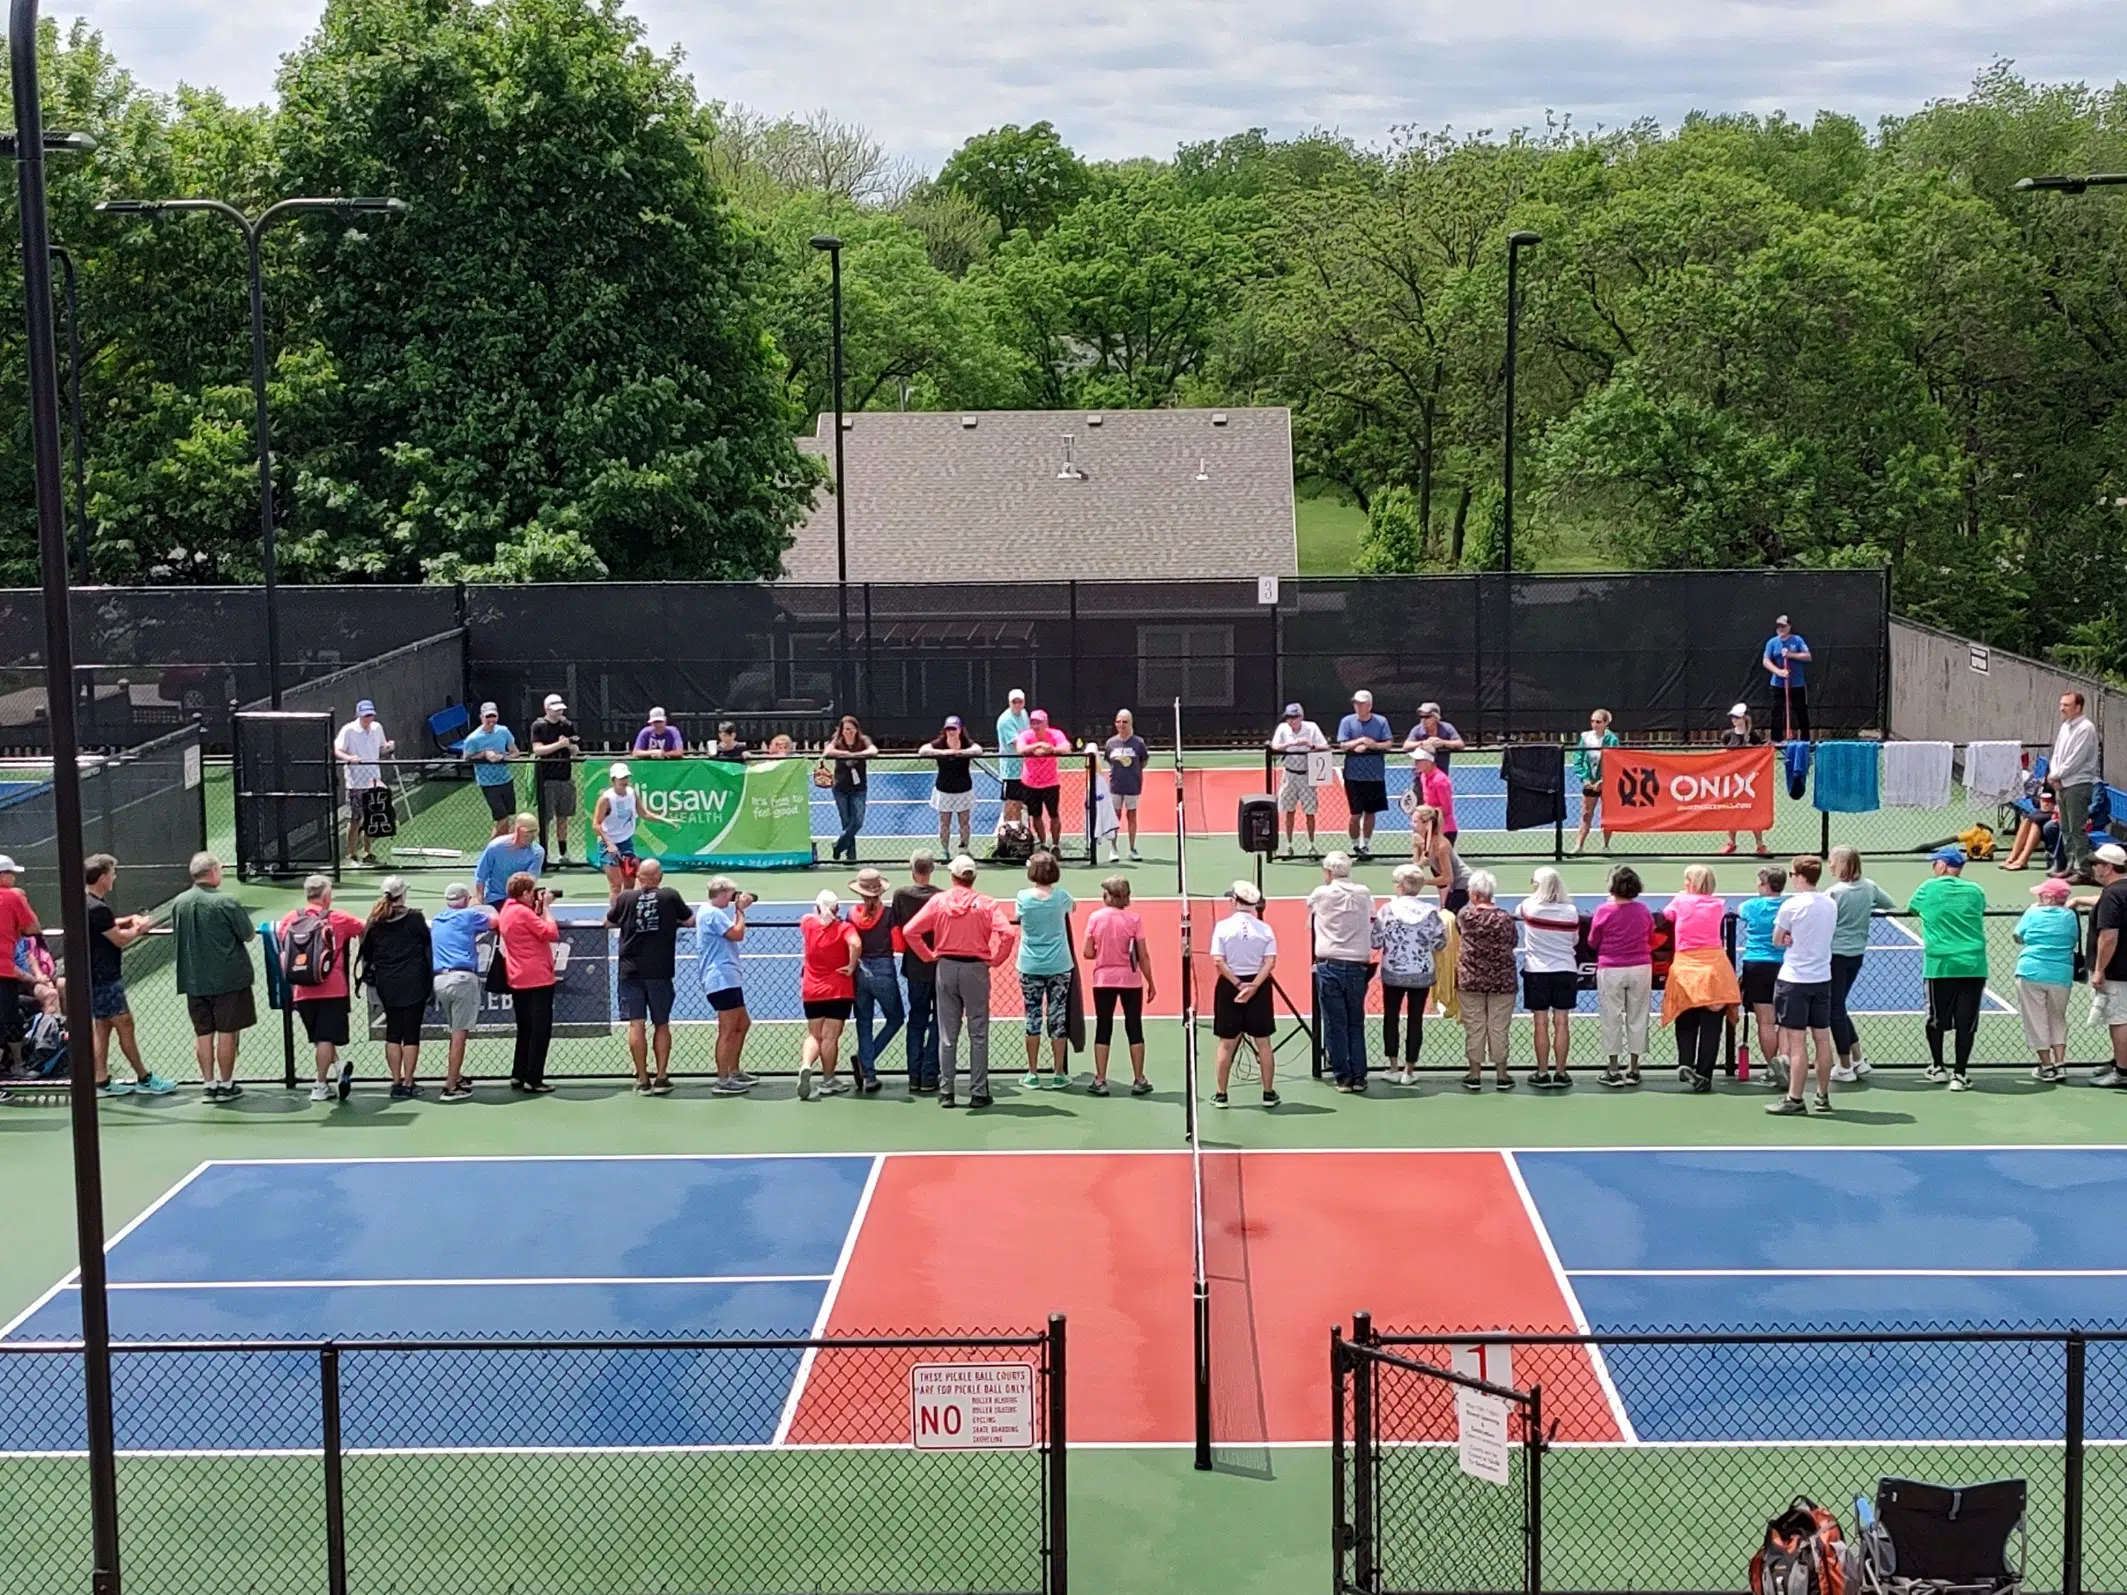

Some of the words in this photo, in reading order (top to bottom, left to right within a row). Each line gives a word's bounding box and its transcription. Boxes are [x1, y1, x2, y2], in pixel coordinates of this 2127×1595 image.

[1264, 580, 1273, 600] 3
[1315, 756, 1326, 781] 2
[1670, 772, 1756, 802] ONIX
[920, 1372, 942, 1382] THESE
[945, 1372, 972, 1381] PICKLE
[975, 1371, 994, 1381] BALL
[996, 1371, 1026, 1381] COURTS
[1466, 1343, 1488, 1397] 1
[919, 1385, 934, 1395] ARE
[937, 1385, 952, 1395] FOR
[954, 1385, 981, 1394] PICKLE
[984, 1384, 1002, 1394] BALL
[1005, 1384, 1026, 1394] ONLY
[920, 1405, 962, 1435] NO
[991, 1425, 1019, 1433] BOARDING
